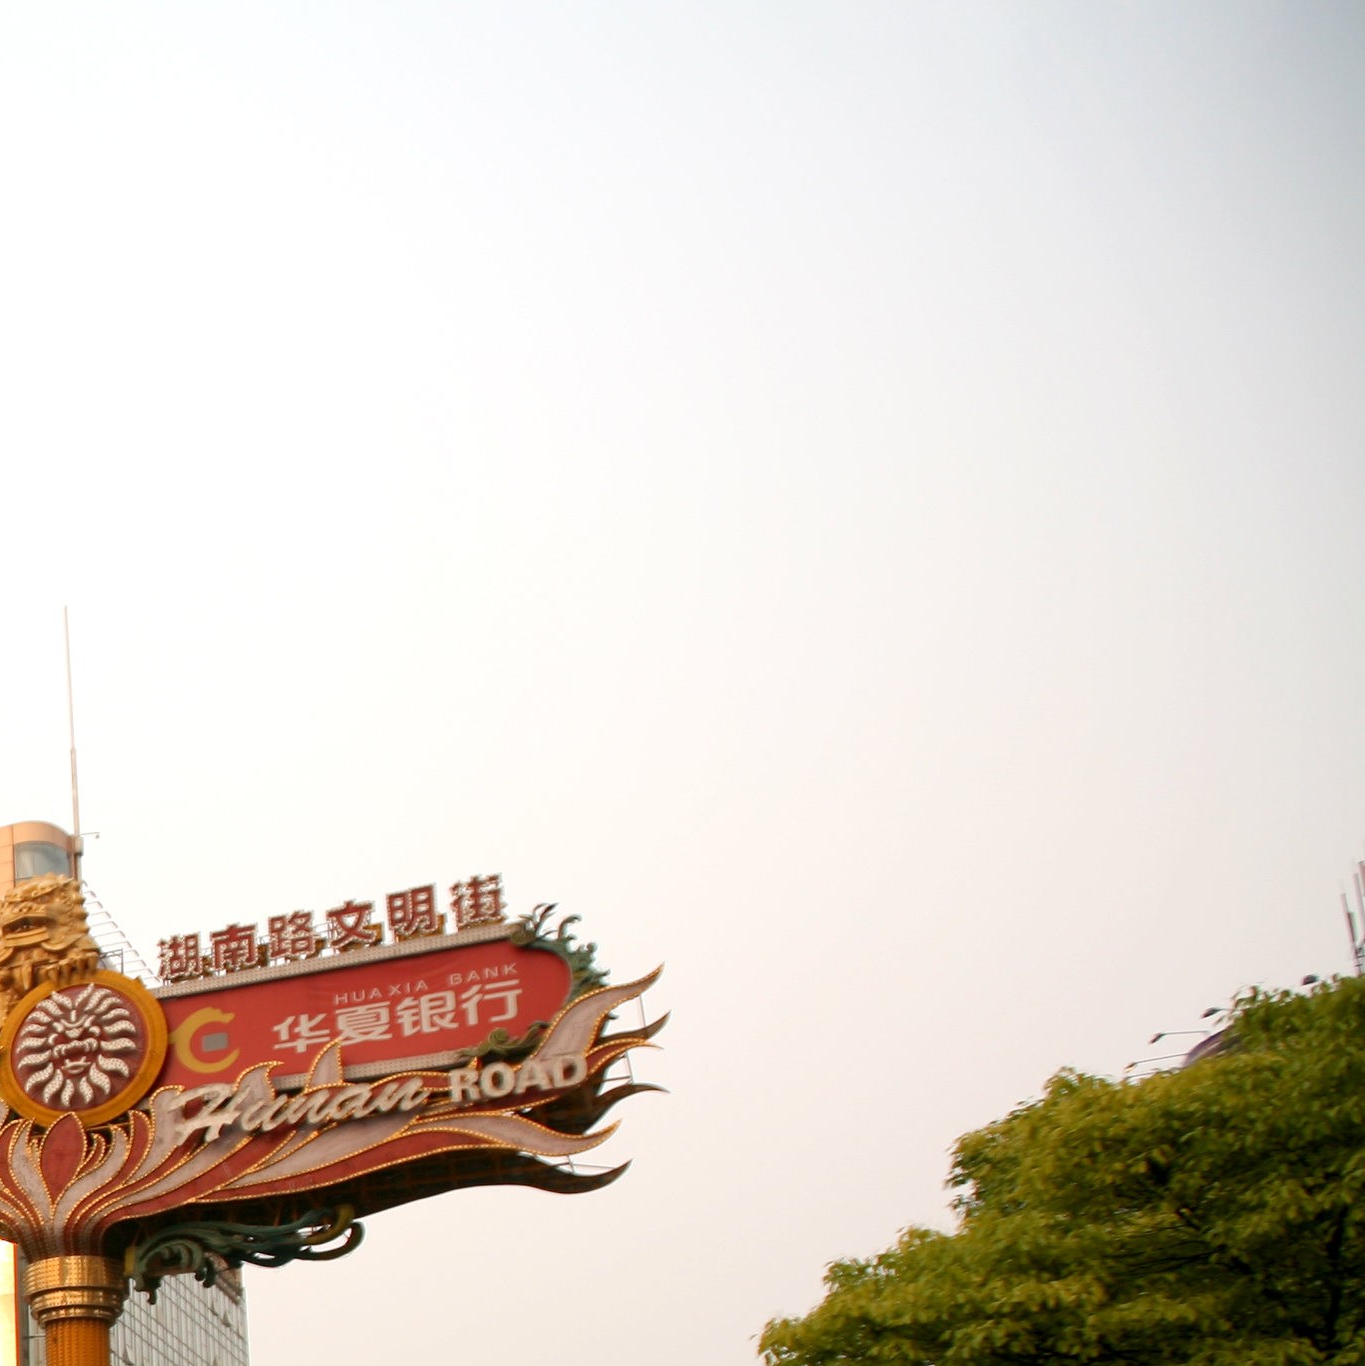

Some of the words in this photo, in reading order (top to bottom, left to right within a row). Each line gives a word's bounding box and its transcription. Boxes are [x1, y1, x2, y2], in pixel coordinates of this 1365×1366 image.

[156, 873, 507, 980] 湖南路文明街
[272, 978, 523, 1053] 华夏银行
[334, 979, 429, 1005] HUAXIA
[448, 962, 520, 988] BANK
[166, 1077, 430, 1149] Hunan
[448, 1053, 589, 1103] ROAD
